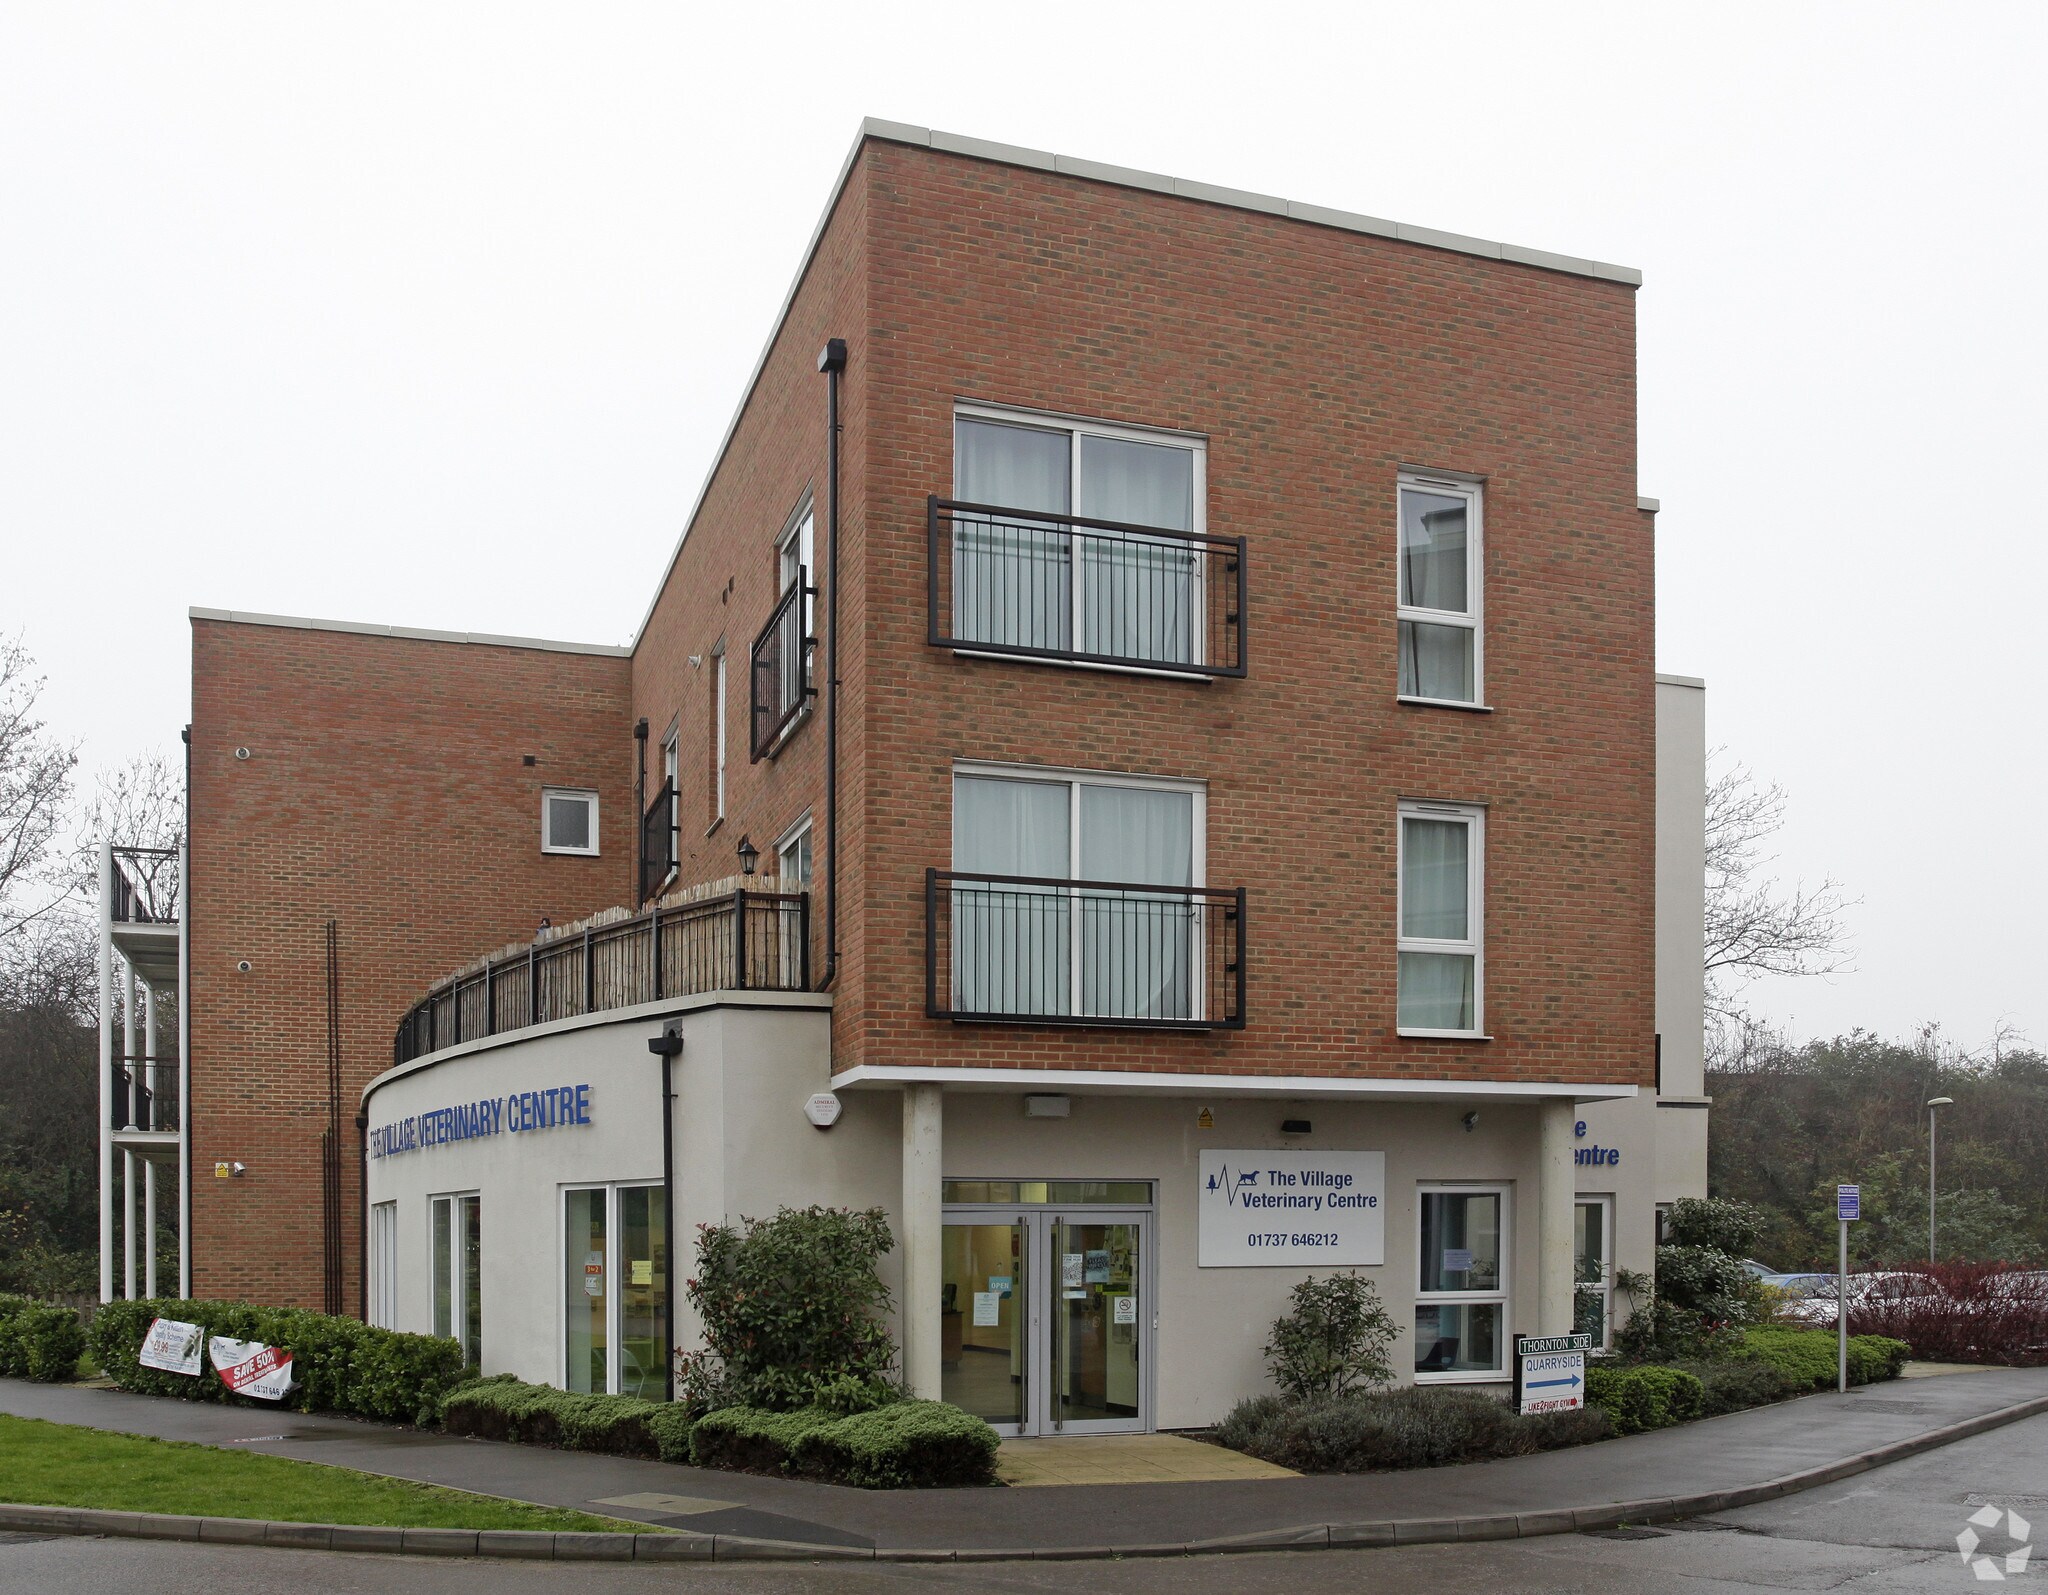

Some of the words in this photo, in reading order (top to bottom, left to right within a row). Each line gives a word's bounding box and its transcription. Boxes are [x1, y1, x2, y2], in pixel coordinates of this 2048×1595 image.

[382, 1116, 416, 1156] VILLAGE
[418, 1097, 503, 1148] VETERINARY
[507, 1084, 592, 1133] CENTRE
[1575, 1144, 1620, 1166] ntre
[1267, 1170, 1297, 1187] The
[1300, 1170, 1353, 1190] Village
[1241, 1192, 1323, 1211] Veterinary
[1326, 1192, 1378, 1208] Centre
[1247, 1233, 1288, 1247] 01737
[1291, 1233, 1339, 1247] 646212
[1522, 1338, 1569, 1353] THORNTON
[1573, 1336, 1589, 1349] SIDE
[233, 1359, 256, 1380] SAVE
[256, 1350, 275, 1369] 50%
[1526, 1355, 1582, 1372] QUARRYSIDE
